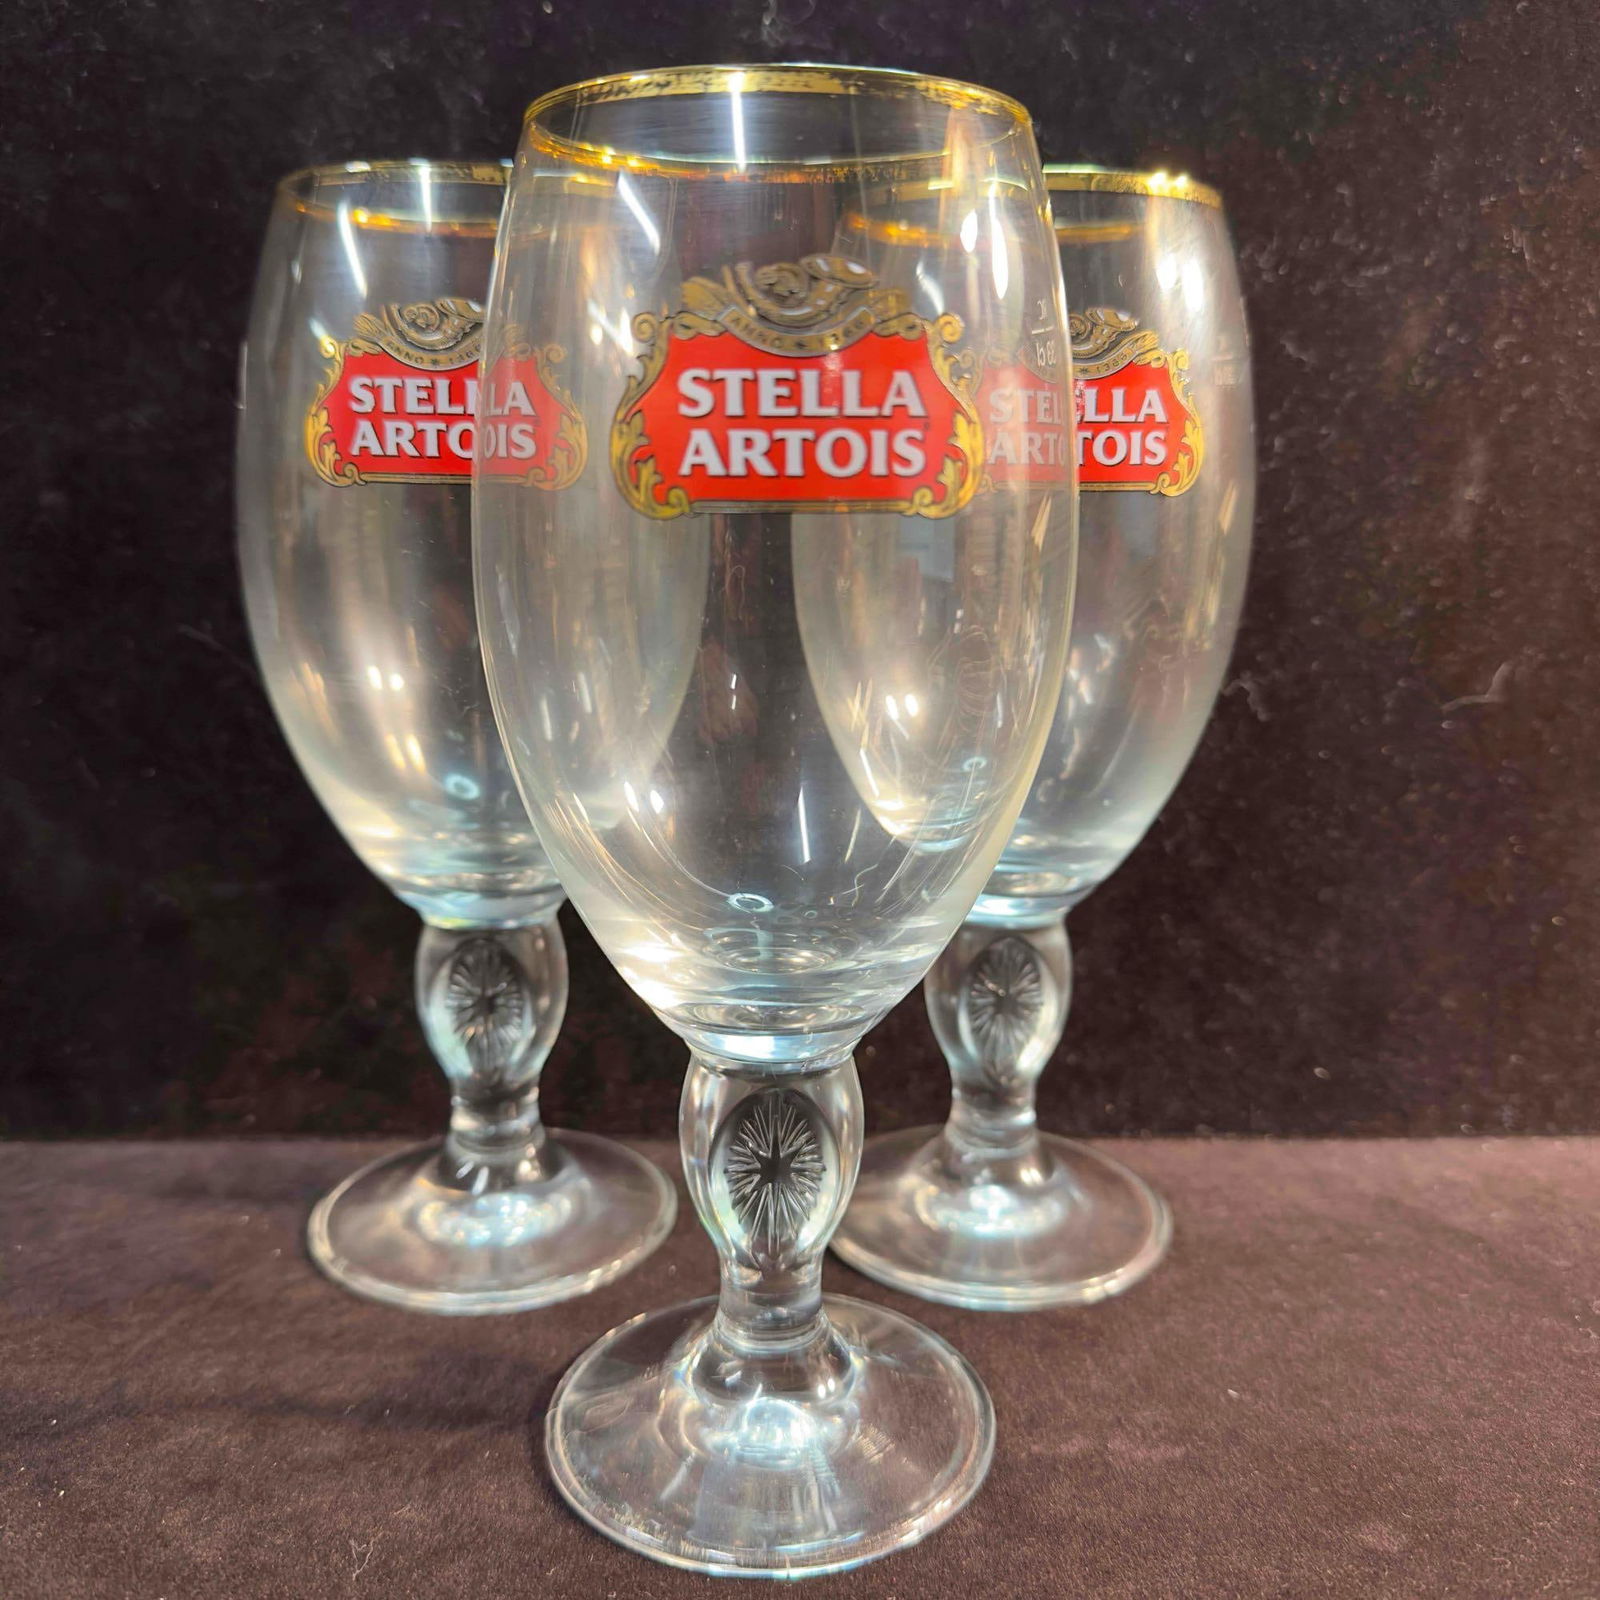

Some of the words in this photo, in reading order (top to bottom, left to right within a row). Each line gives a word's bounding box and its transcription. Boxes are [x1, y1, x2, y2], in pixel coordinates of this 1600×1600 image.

[348, 376, 537, 417] STELLA
[677, 368, 927, 418] STELLA
[350, 420, 537, 460] ARTOIS
[678, 428, 927, 478] ARTOIS
